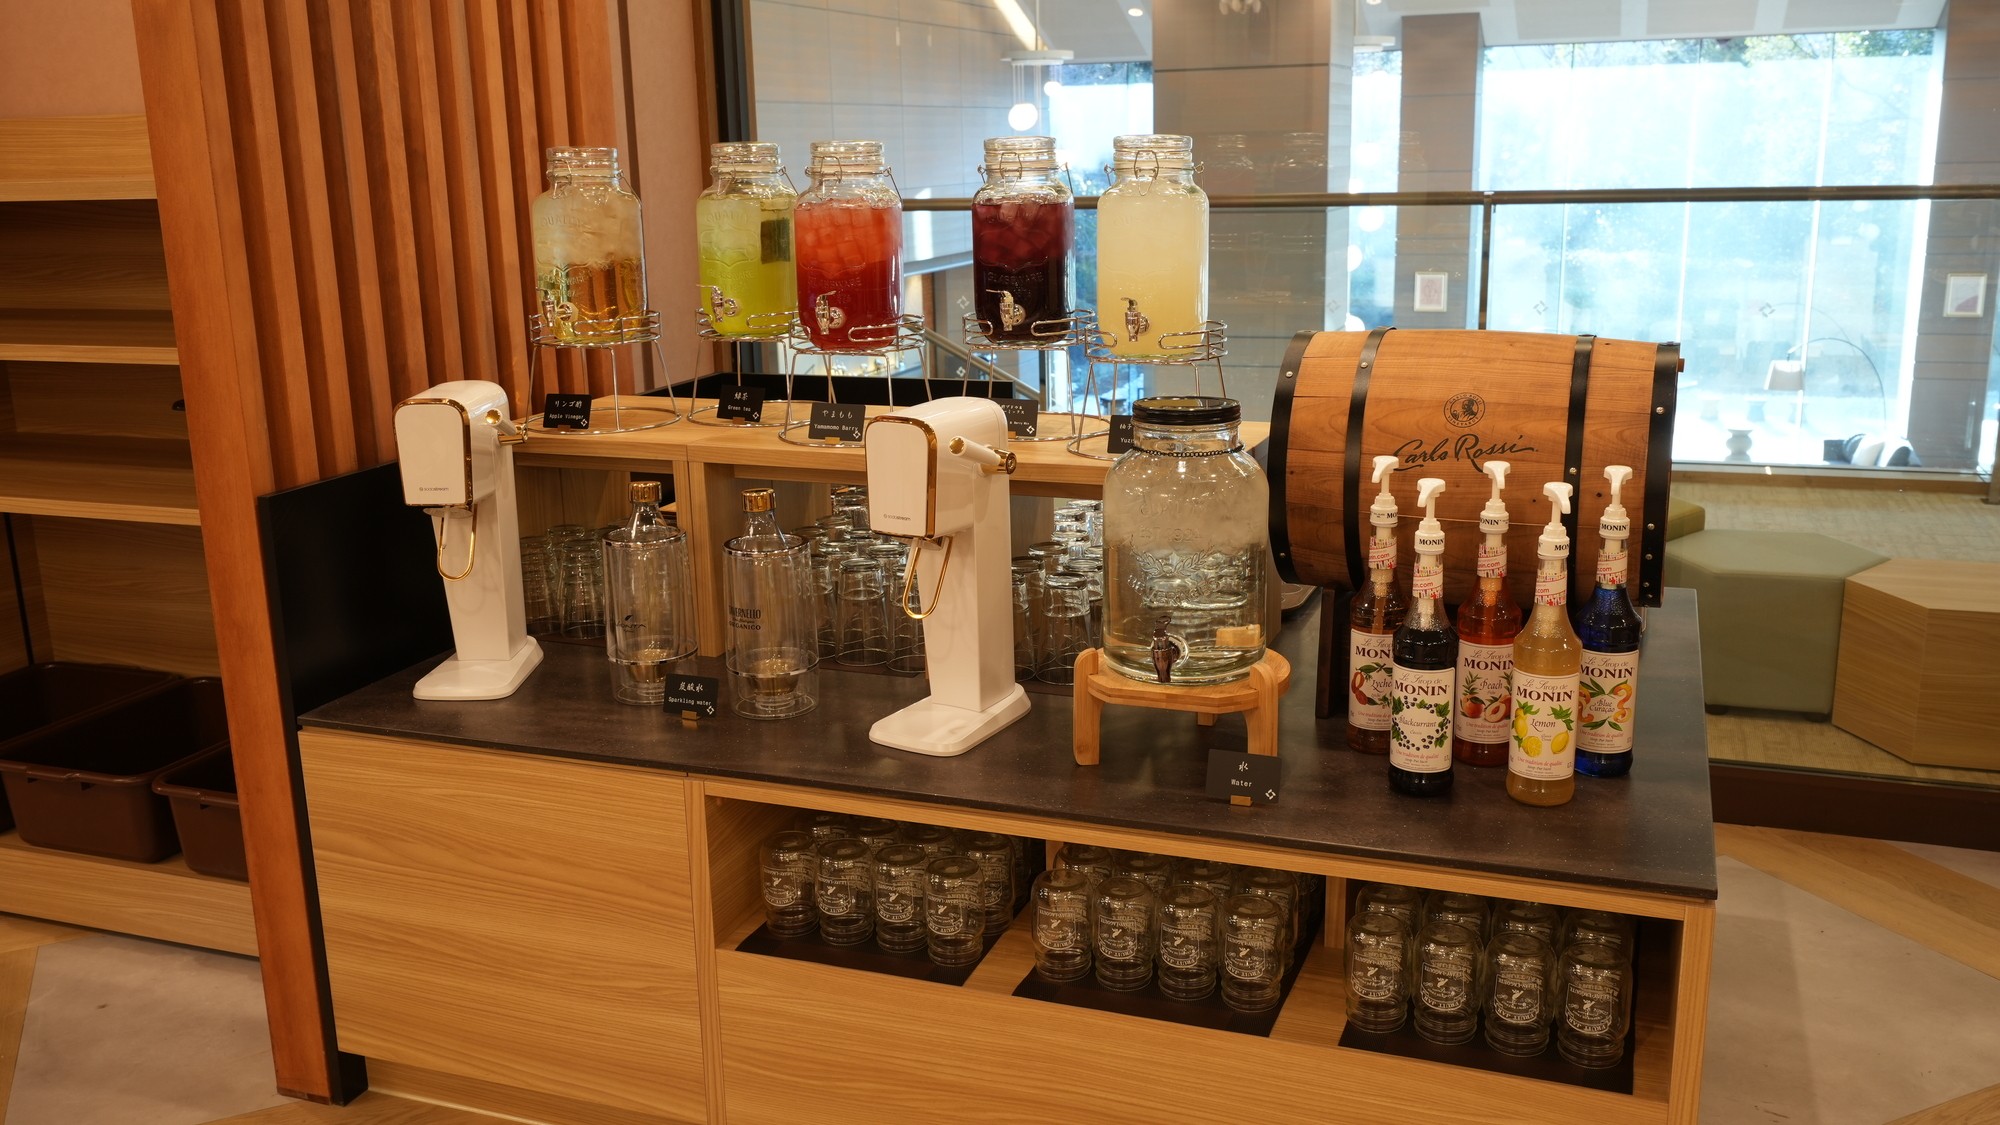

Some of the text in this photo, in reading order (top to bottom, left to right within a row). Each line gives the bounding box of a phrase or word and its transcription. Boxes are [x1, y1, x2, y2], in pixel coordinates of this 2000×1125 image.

[733, 391, 749, 401] 緑茶
[822, 409, 853, 419] やまもも
[814, 423, 840, 431] Yamamomo
[1393, 433, 1536, 473] Carlo Rossi
[1600, 523, 1627, 531] MONIN
[1355, 646, 1392, 659] MON
[1470, 649, 1482, 658] Le
[1483, 650, 1504, 661] Sirop
[1464, 657, 1514, 671] MONIN
[1585, 656, 1596, 665] Le
[1598, 657, 1619, 668] Sirop
[1580, 664, 1633, 679] MONIN
[1400, 672, 1410, 681] Le
[1411, 674, 1432, 685] Sirop
[1479, 678, 1503, 690] Peach
[1523, 678, 1533, 687] Le
[1535, 680, 1558, 691] Sirop
[679, 681, 703, 693] 炭酸水
[1394, 680, 1448, 696] MONIN
[1516, 686, 1573, 702] MONIN
[668, 696, 695, 705] Sparkling
[1597, 698, 1612, 707] Blue
[1589, 703, 1615, 713] Curaçao
[1399, 715, 1437, 727] Blackcurrant
[1530, 718, 1556, 732] Lemon
[1238, 761, 1249, 772] 水
[1231, 778, 1252, 787] Water
[1423, 996, 1437, 1006] JAR
[1497, 1009, 1511, 1018] JAR
[1568, 1019, 1582, 1029] JAR
